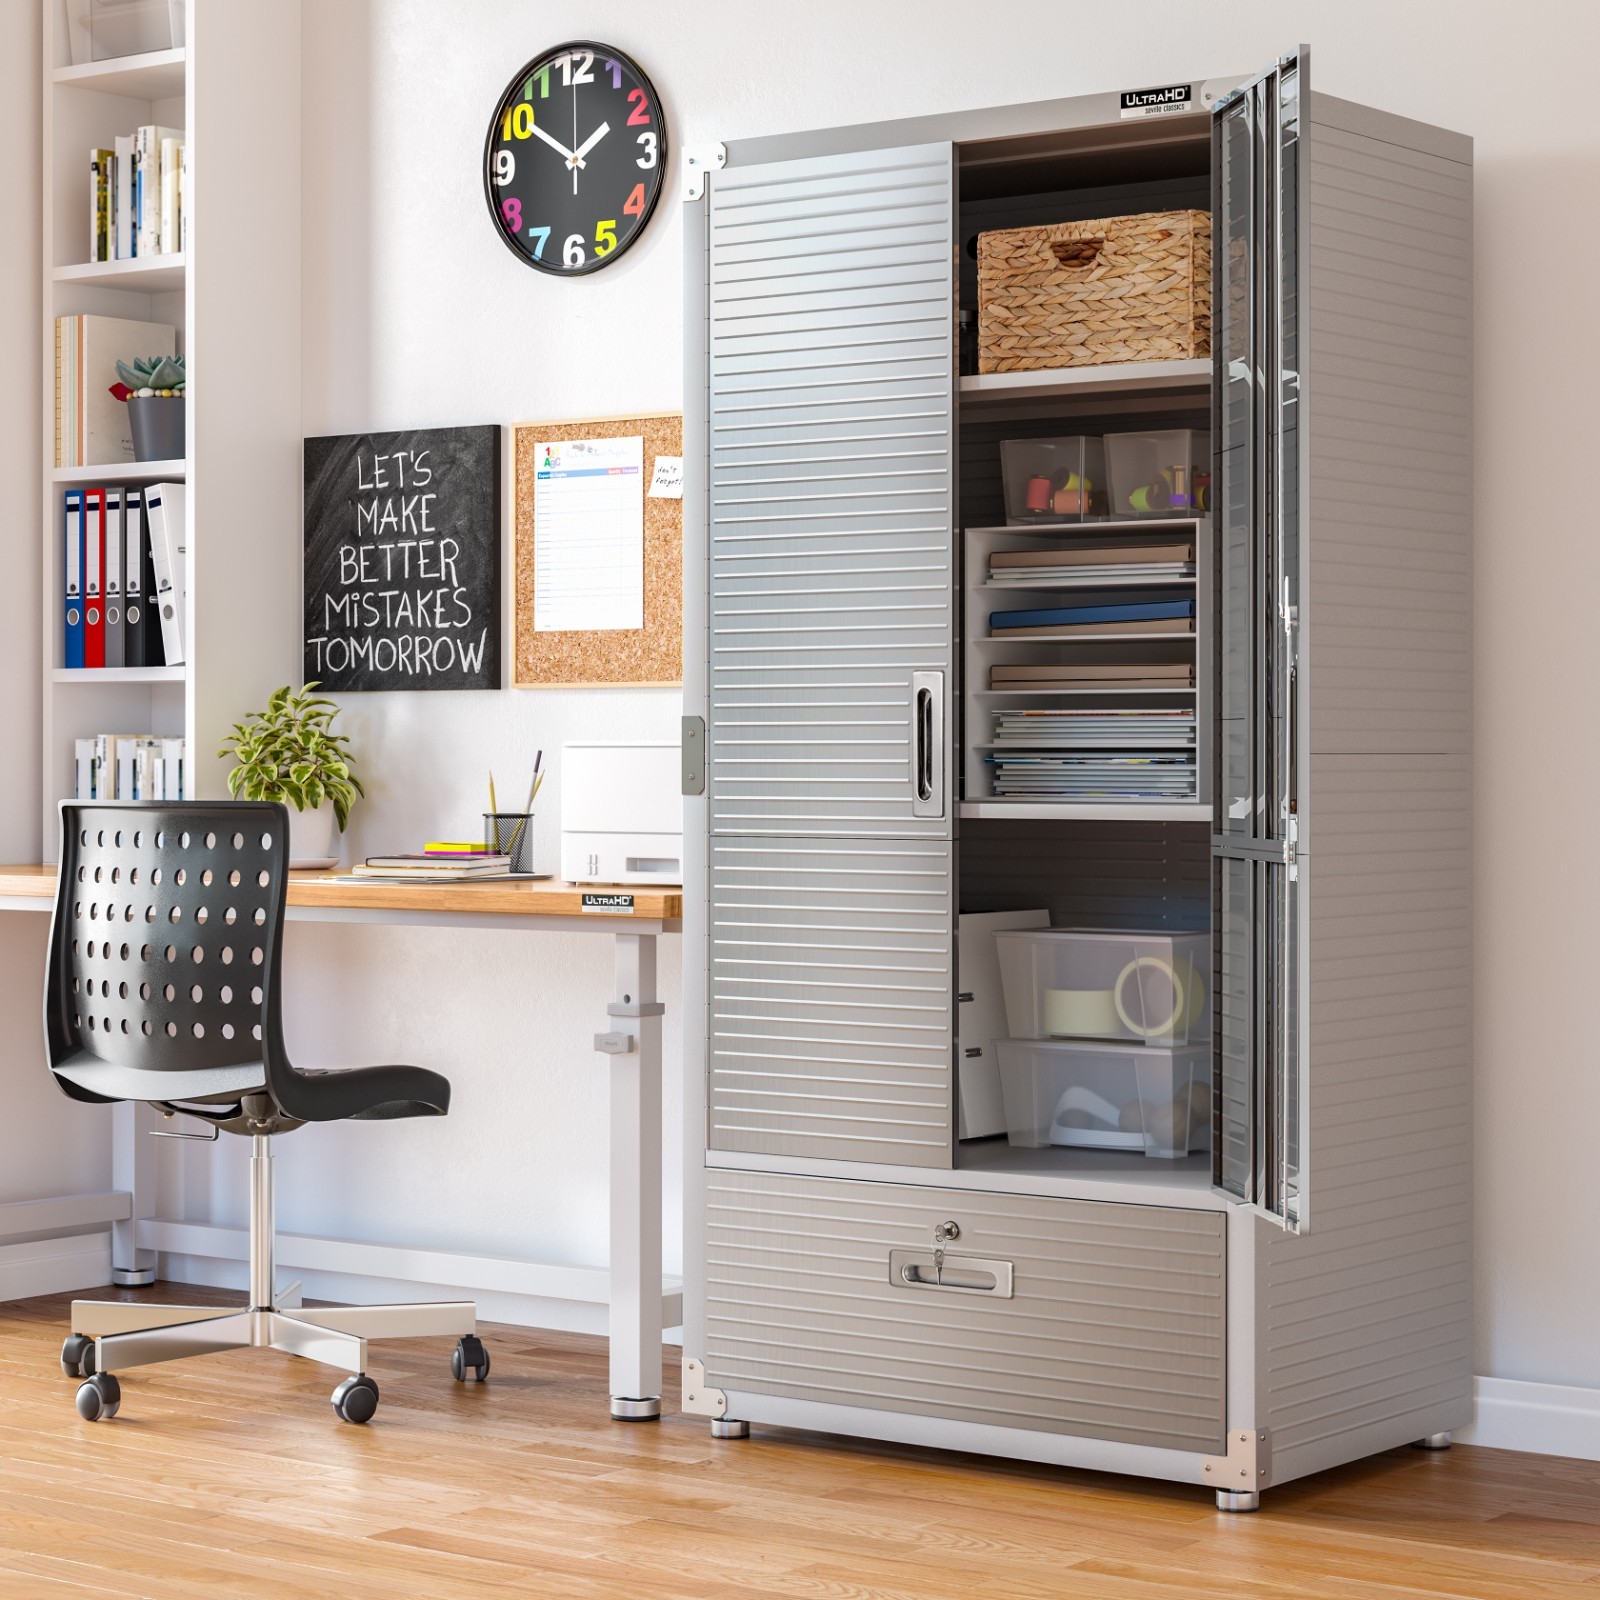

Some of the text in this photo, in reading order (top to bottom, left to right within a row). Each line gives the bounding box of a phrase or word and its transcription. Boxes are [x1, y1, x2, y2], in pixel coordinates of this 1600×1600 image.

[524, 64, 550, 100] 11
[554, 50, 595, 86] 12
[605, 58, 622, 89] 1
[501, 103, 535, 141] 10
[626, 88, 650, 127] 2
[493, 149, 516, 187] 9
[636, 131, 657, 170] 3
[500, 197, 523, 234] 8
[623, 182, 646, 220] 4
[528, 226, 551, 261] 7
[562, 233, 586, 269] 6
[594, 219, 617, 258] 5
[357, 450, 432, 490] LET'S
[357, 494, 437, 536] MAKE
[339, 538, 460, 588] BETTER
[307, 627, 488, 676] TOMORROW
